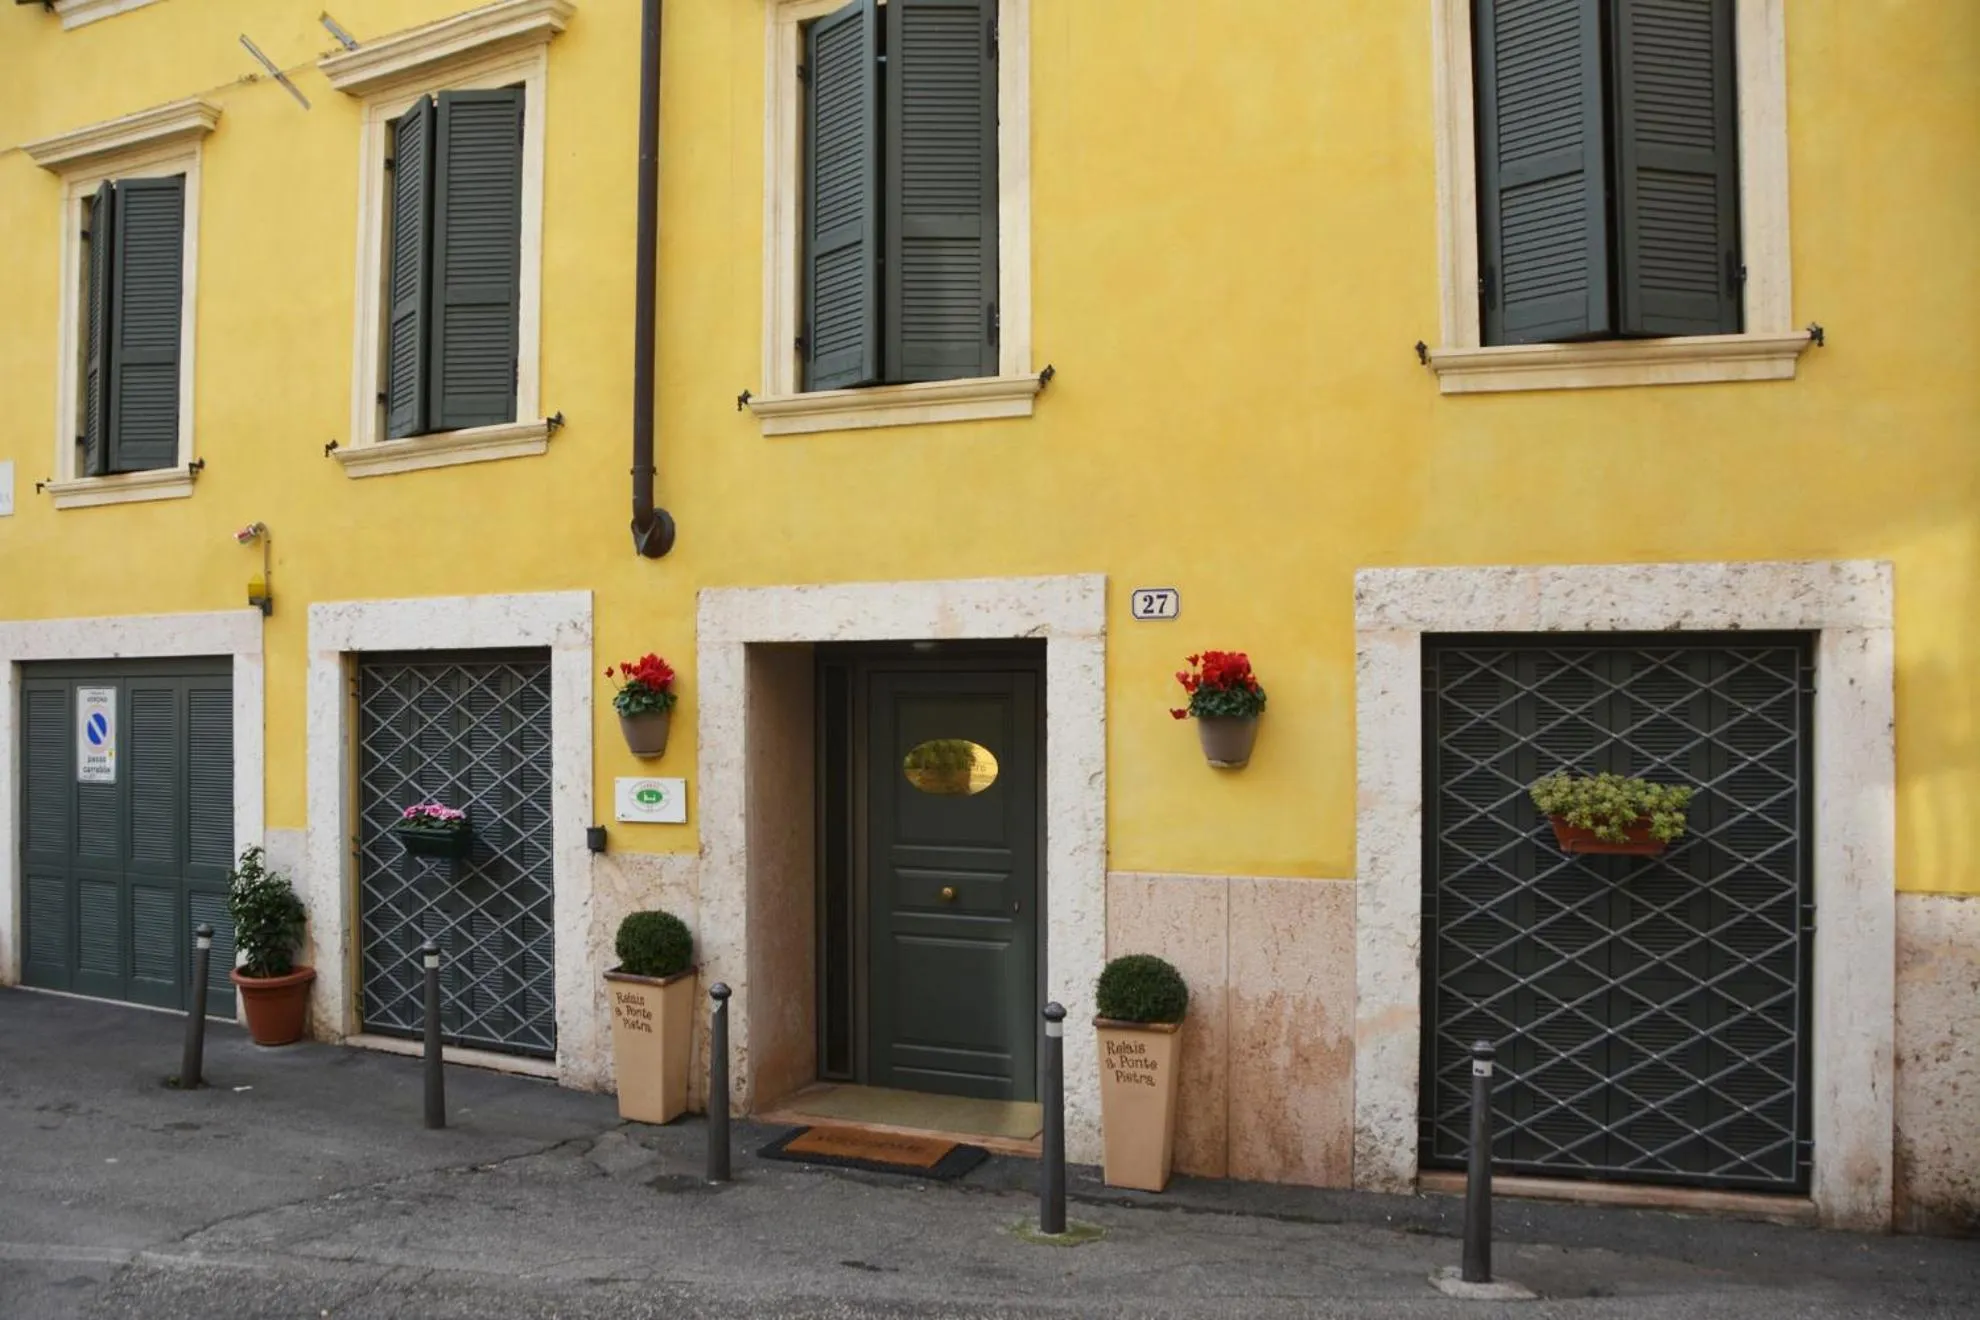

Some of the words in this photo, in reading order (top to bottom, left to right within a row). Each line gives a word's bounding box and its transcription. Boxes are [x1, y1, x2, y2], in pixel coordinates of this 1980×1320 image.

[1143, 594, 1168, 614] 27
[626, 1004, 653, 1021] Ponte
[1106, 1040, 1146, 1056] Relais
[1120, 1055, 1158, 1071] Ponte
[1115, 1069, 1156, 1088] Pietra
